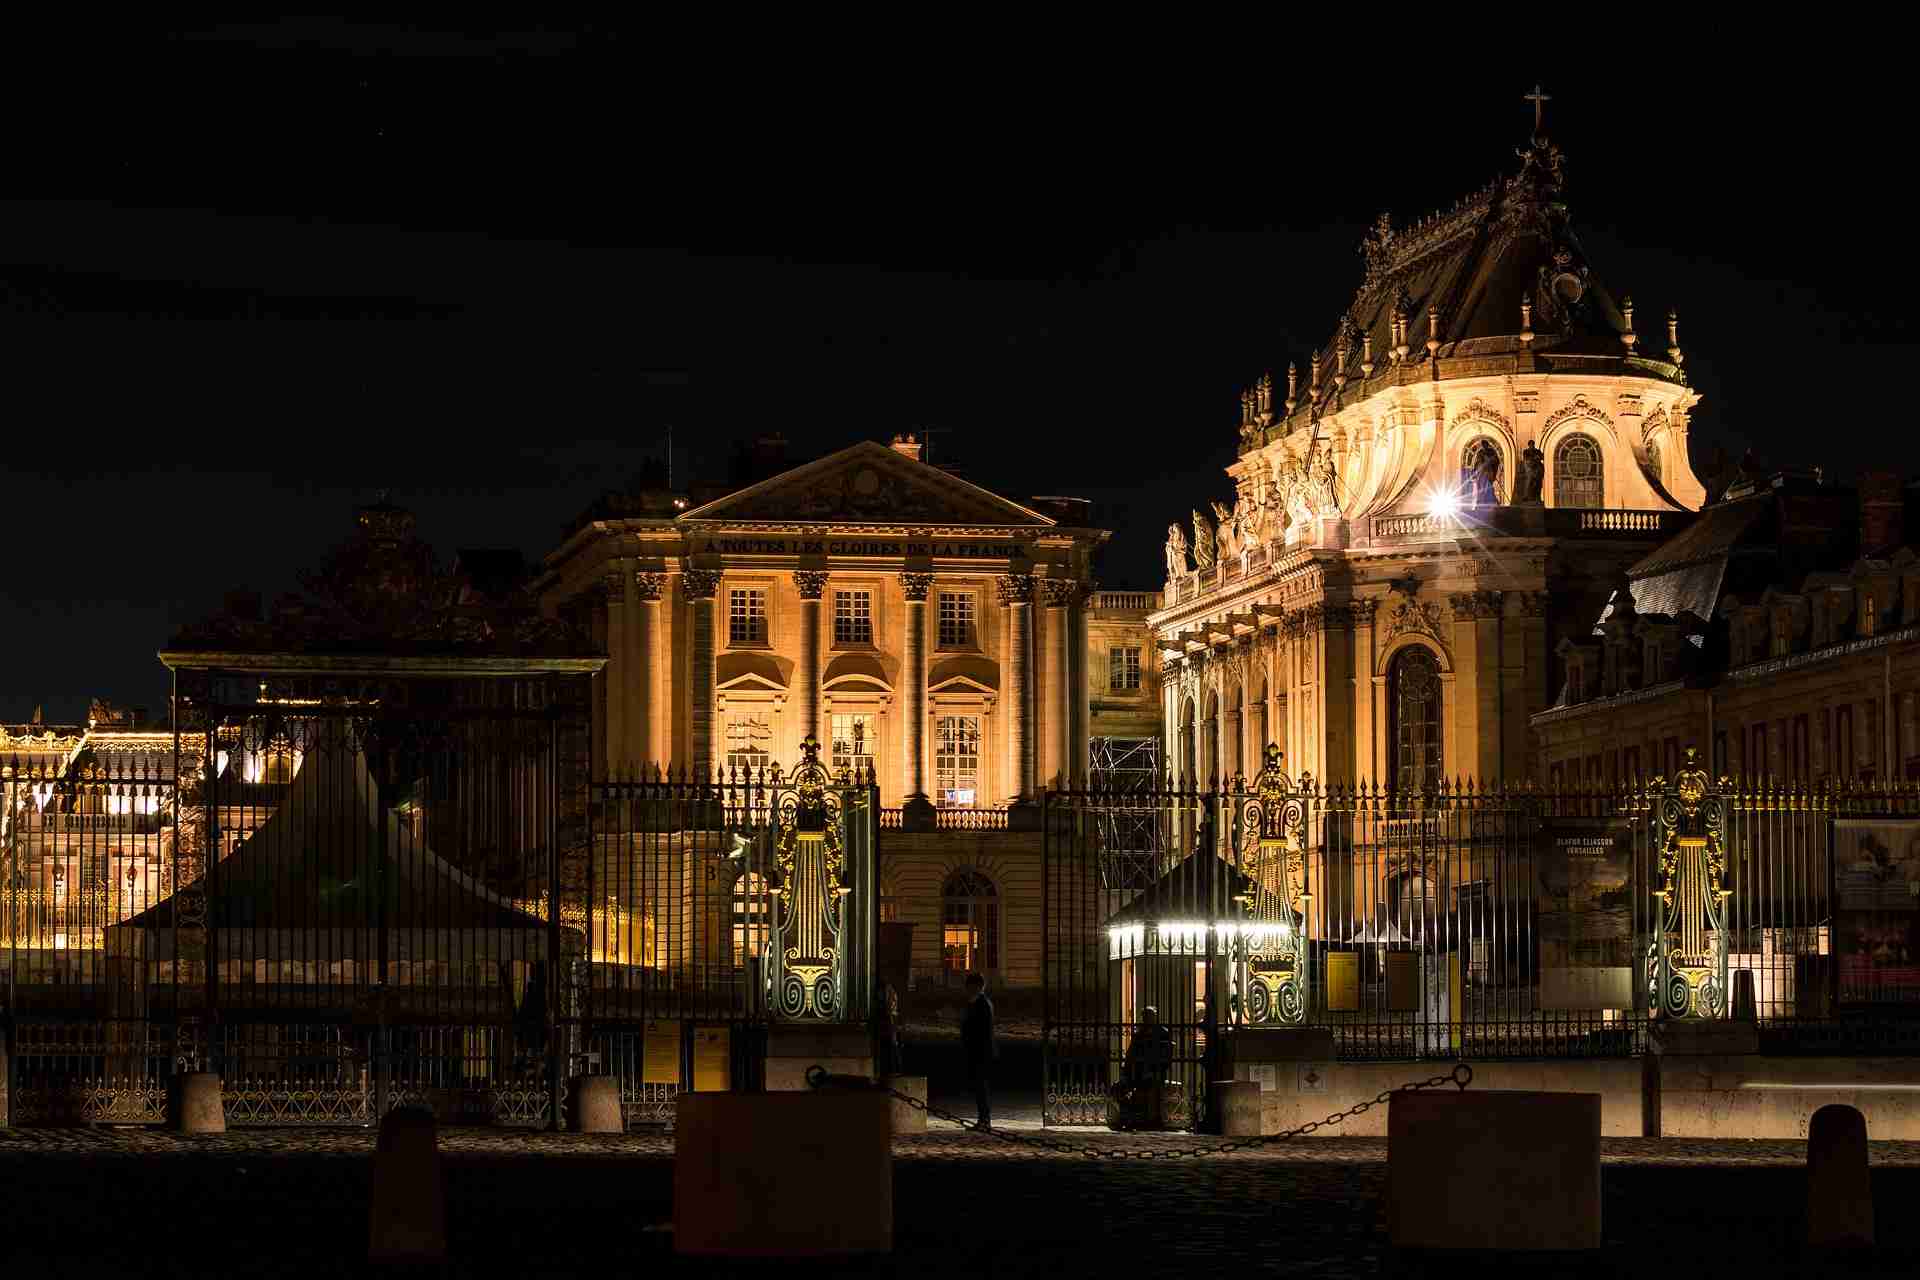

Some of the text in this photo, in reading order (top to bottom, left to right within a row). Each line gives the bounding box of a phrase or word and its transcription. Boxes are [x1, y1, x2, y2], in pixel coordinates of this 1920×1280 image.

[719, 540, 785, 554] TOUTES
[792, 542, 824, 554] LES
[829, 543, 901, 556] GLOIRES
[906, 544, 928, 556] DE
[931, 545, 953, 557] LA
[958, 545, 1024, 558] FRANCE
